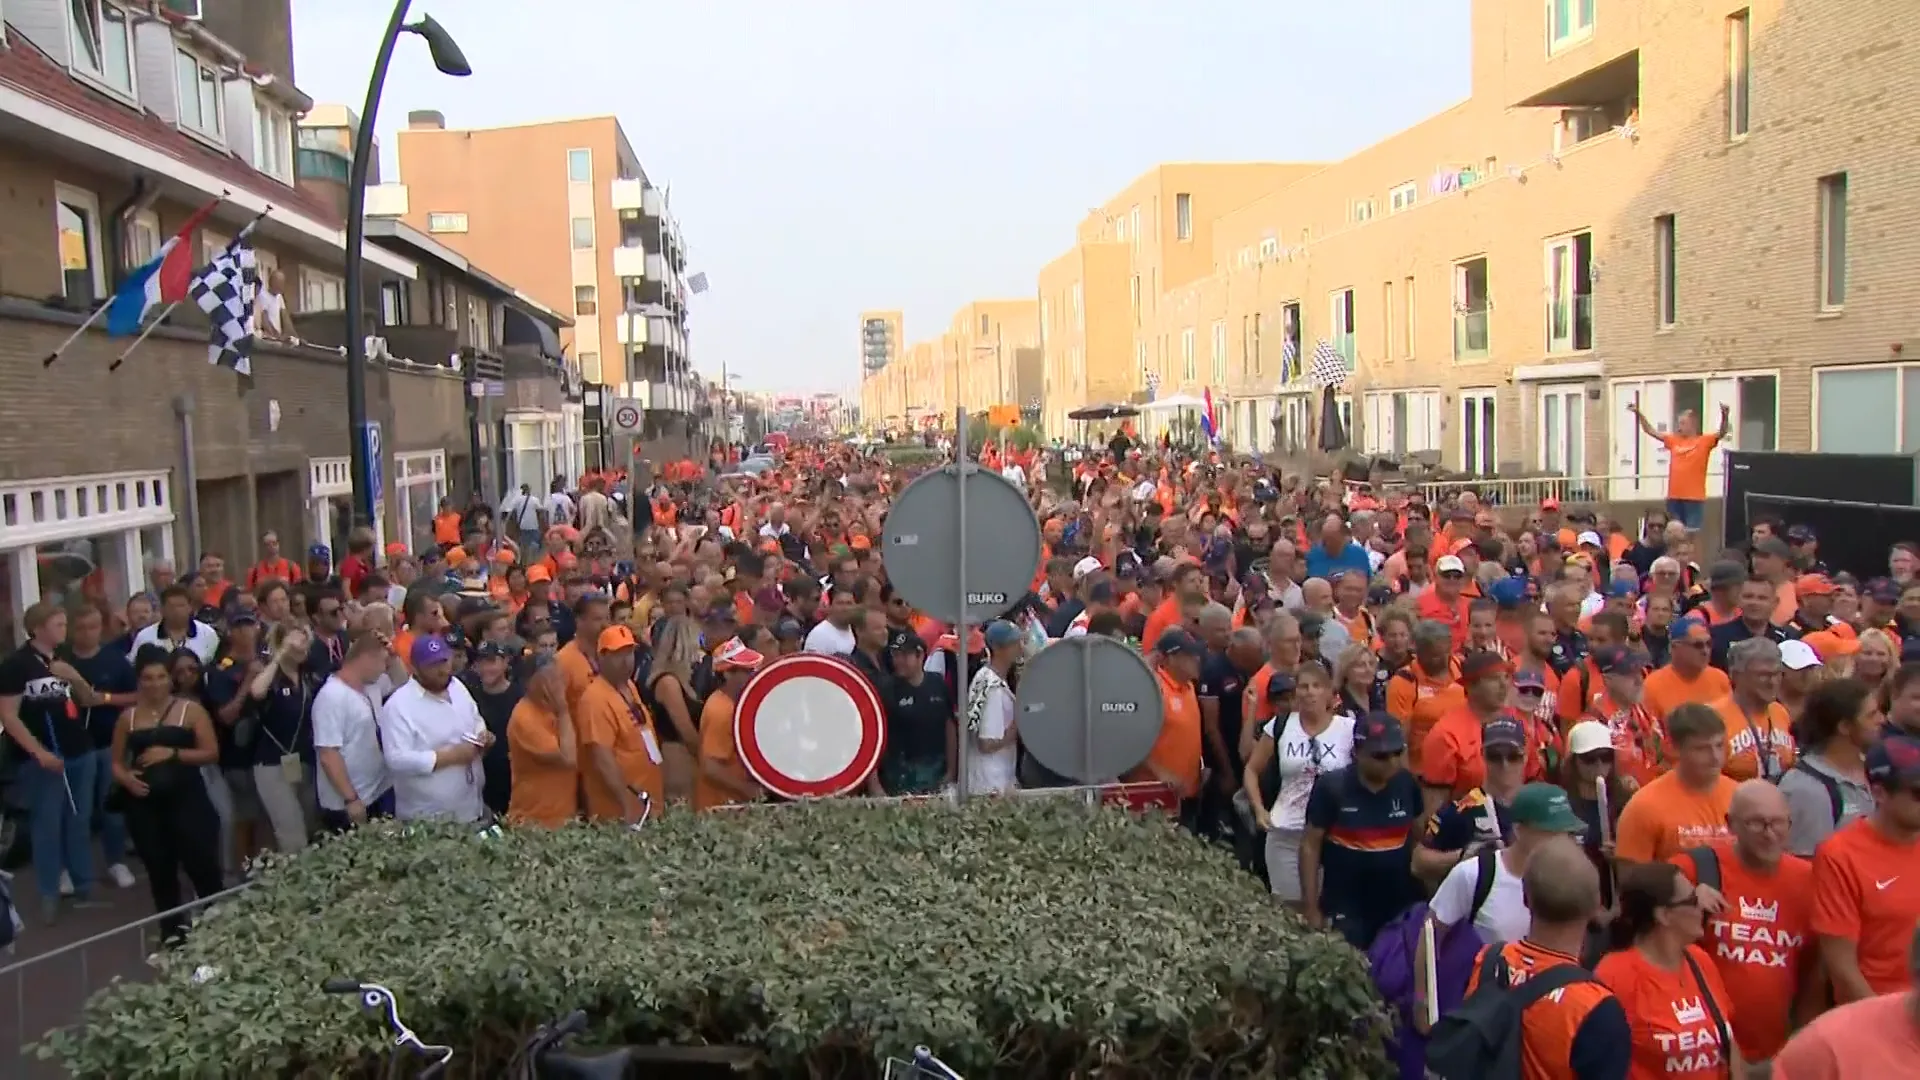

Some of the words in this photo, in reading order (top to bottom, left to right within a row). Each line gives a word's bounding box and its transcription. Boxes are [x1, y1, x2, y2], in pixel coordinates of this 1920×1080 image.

[621, 413, 634, 422] 30
[371, 429, 380, 468] P
[967, 593, 1004, 604] BUKO
[1101, 702, 1135, 711] BUKO
[1287, 742, 1337, 758] MAX
[1711, 919, 1803, 947] TEAM
[1716, 943, 1787, 968] MAX
